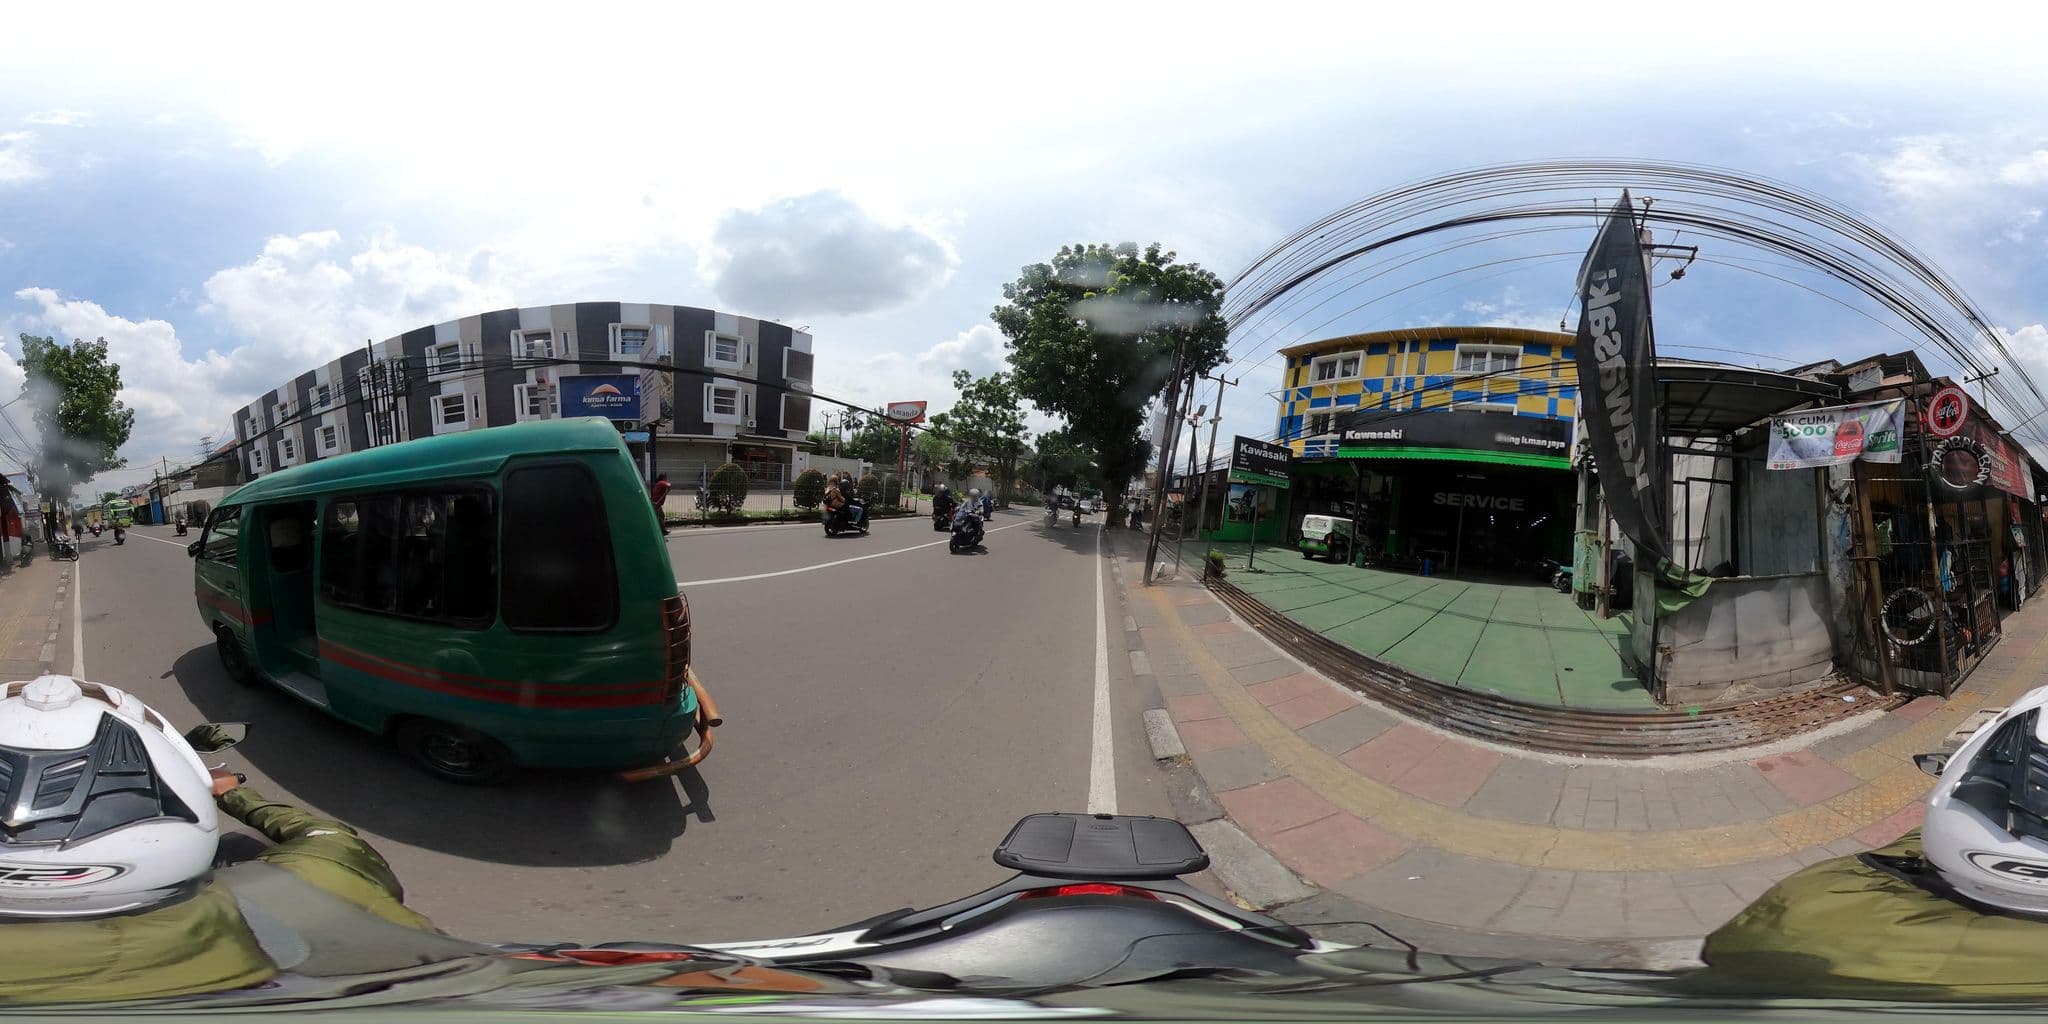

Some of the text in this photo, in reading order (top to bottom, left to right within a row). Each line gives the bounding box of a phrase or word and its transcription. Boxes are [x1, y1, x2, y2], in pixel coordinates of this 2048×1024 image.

[606, 395, 631, 403] farma
[1798, 414, 1835, 425] CUMA
[1345, 428, 1403, 440] Kawasaki
[1868, 430, 1897, 445] Sprite
[1239, 442, 1289, 463] Kawasaki
[1433, 491, 1525, 512] SERVICE
